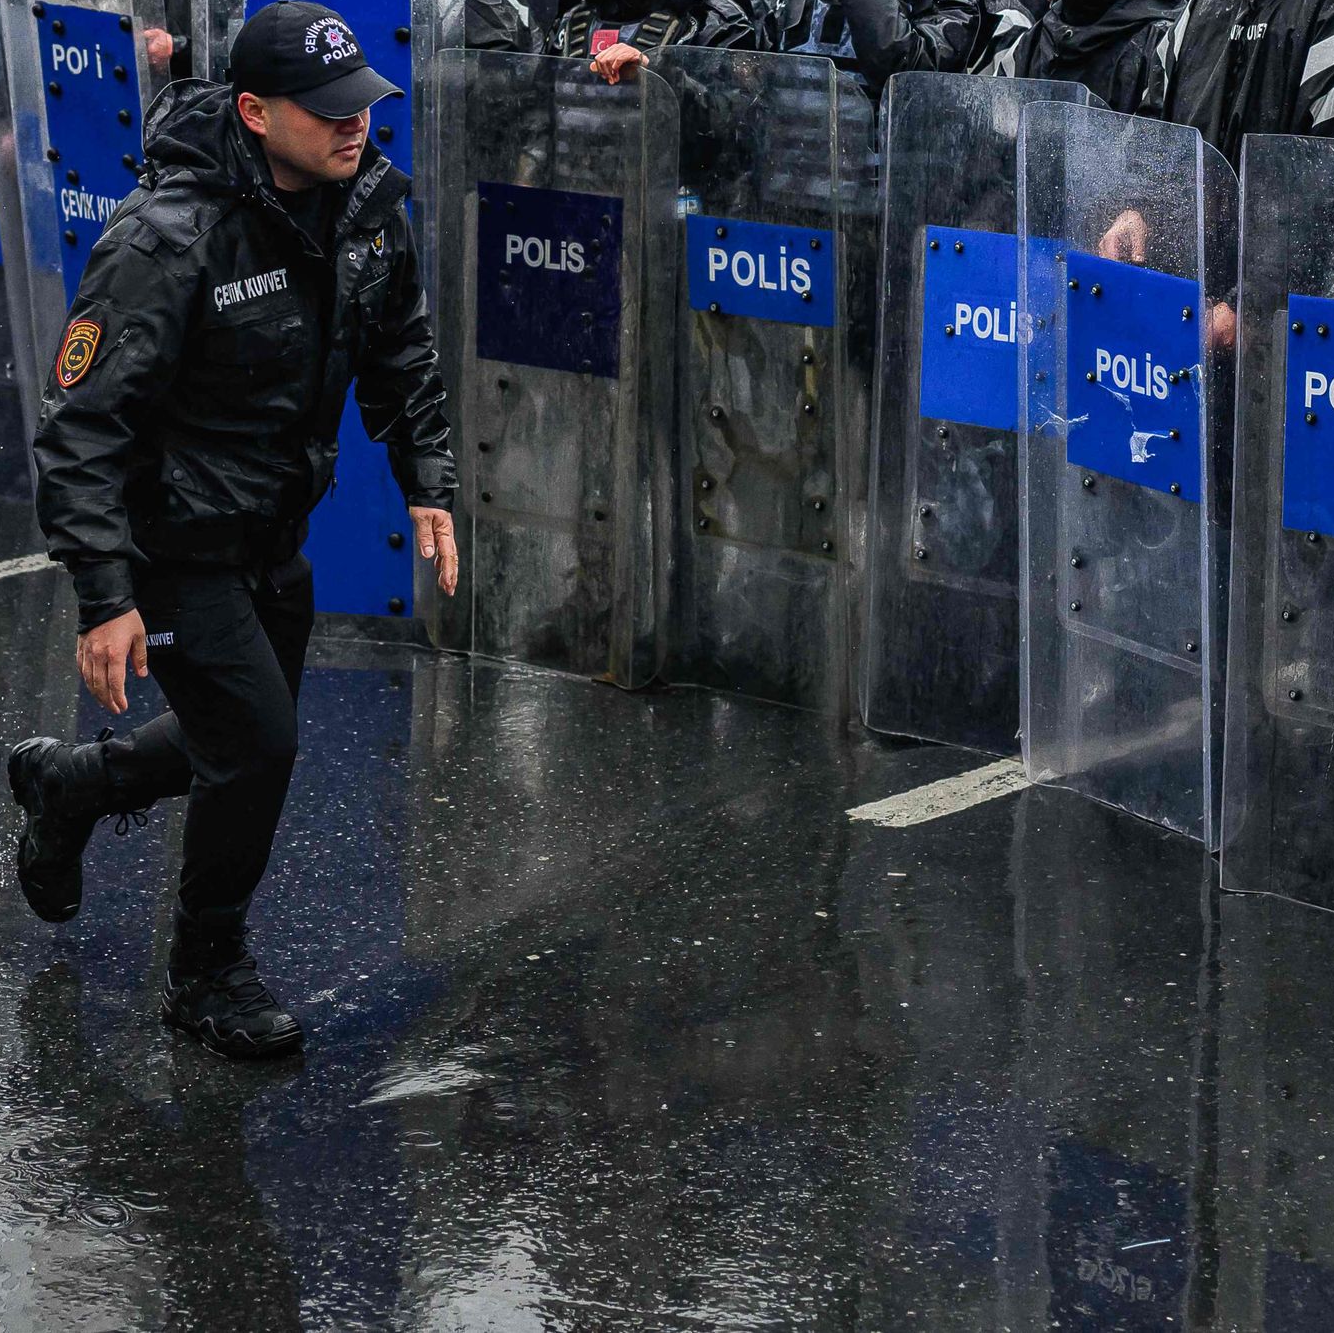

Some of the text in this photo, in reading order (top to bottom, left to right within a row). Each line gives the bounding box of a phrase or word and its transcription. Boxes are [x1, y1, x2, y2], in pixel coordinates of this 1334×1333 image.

[61, 185, 96, 222] ÇEVİK
[244, 268, 288, 299] KUVVET
[708, 246, 812, 294] POLİS
[955, 301, 1034, 345] POLİS
[1096, 352, 1168, 401] POLİS
